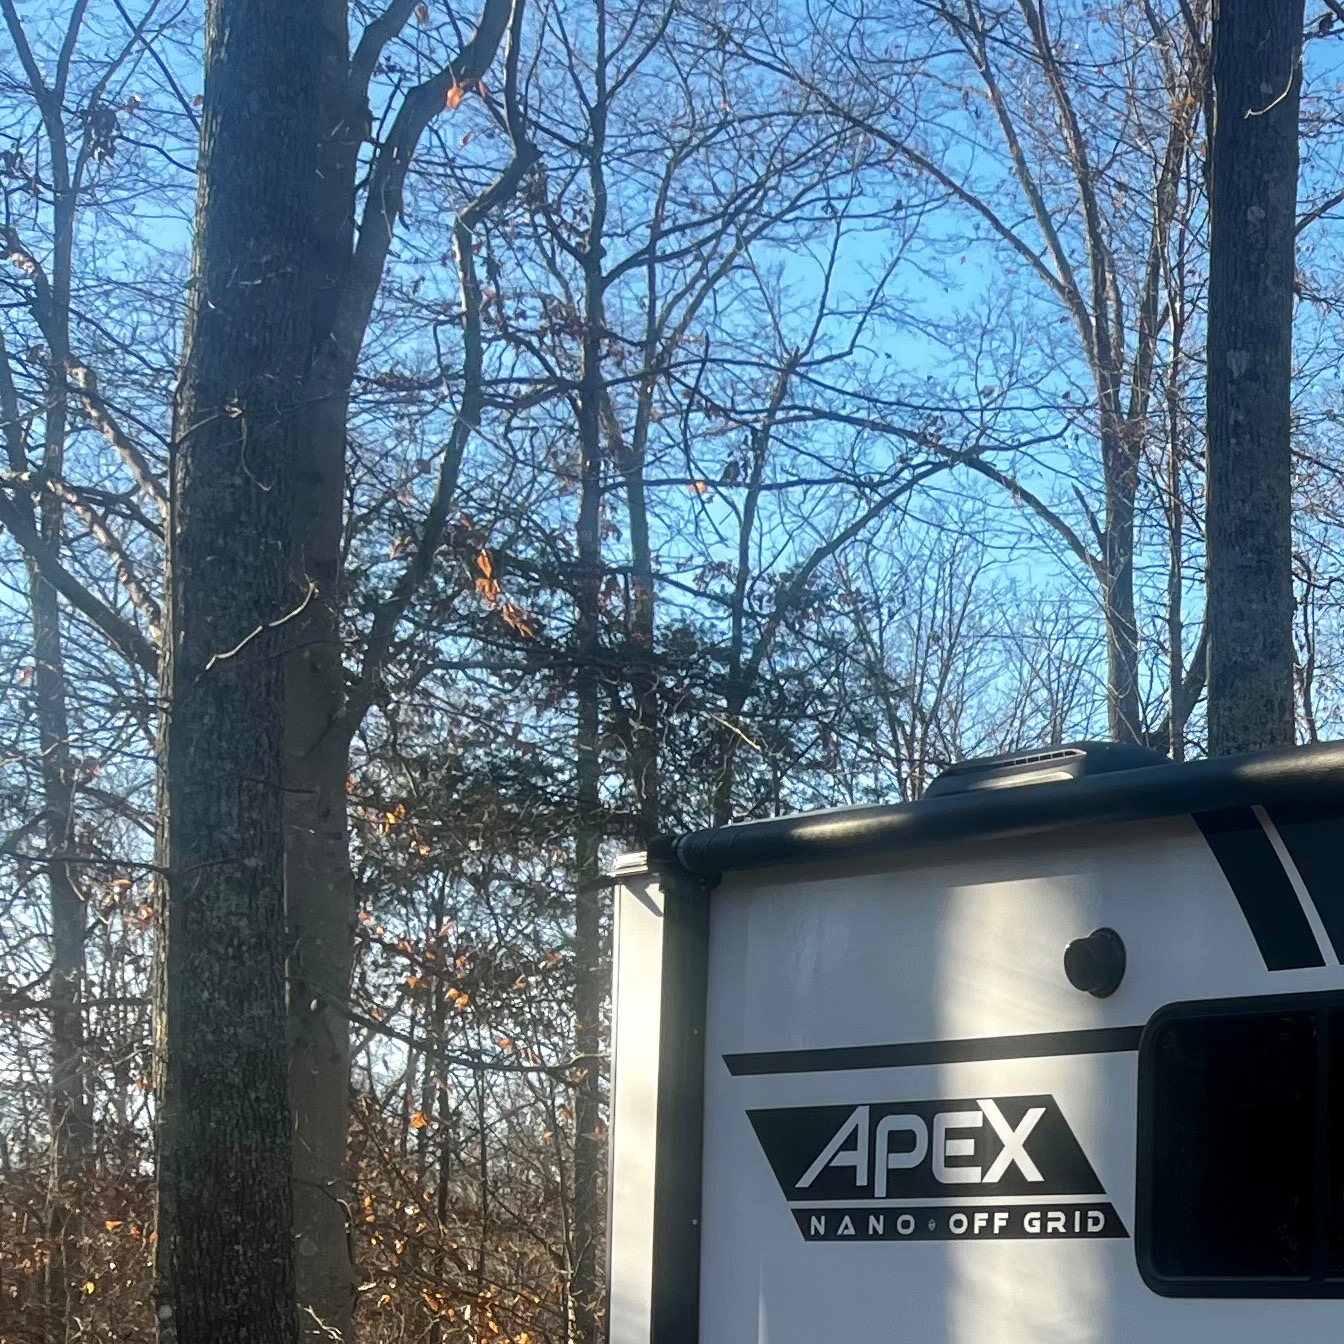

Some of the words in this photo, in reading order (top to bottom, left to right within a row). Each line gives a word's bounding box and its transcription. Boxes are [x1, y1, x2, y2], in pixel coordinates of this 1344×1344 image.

[795, 1099, 1047, 1198] APEX
[810, 1214, 916, 1236] NANO
[948, 1211, 1010, 1235] OFF
[1023, 1210, 1106, 1235] GRID
